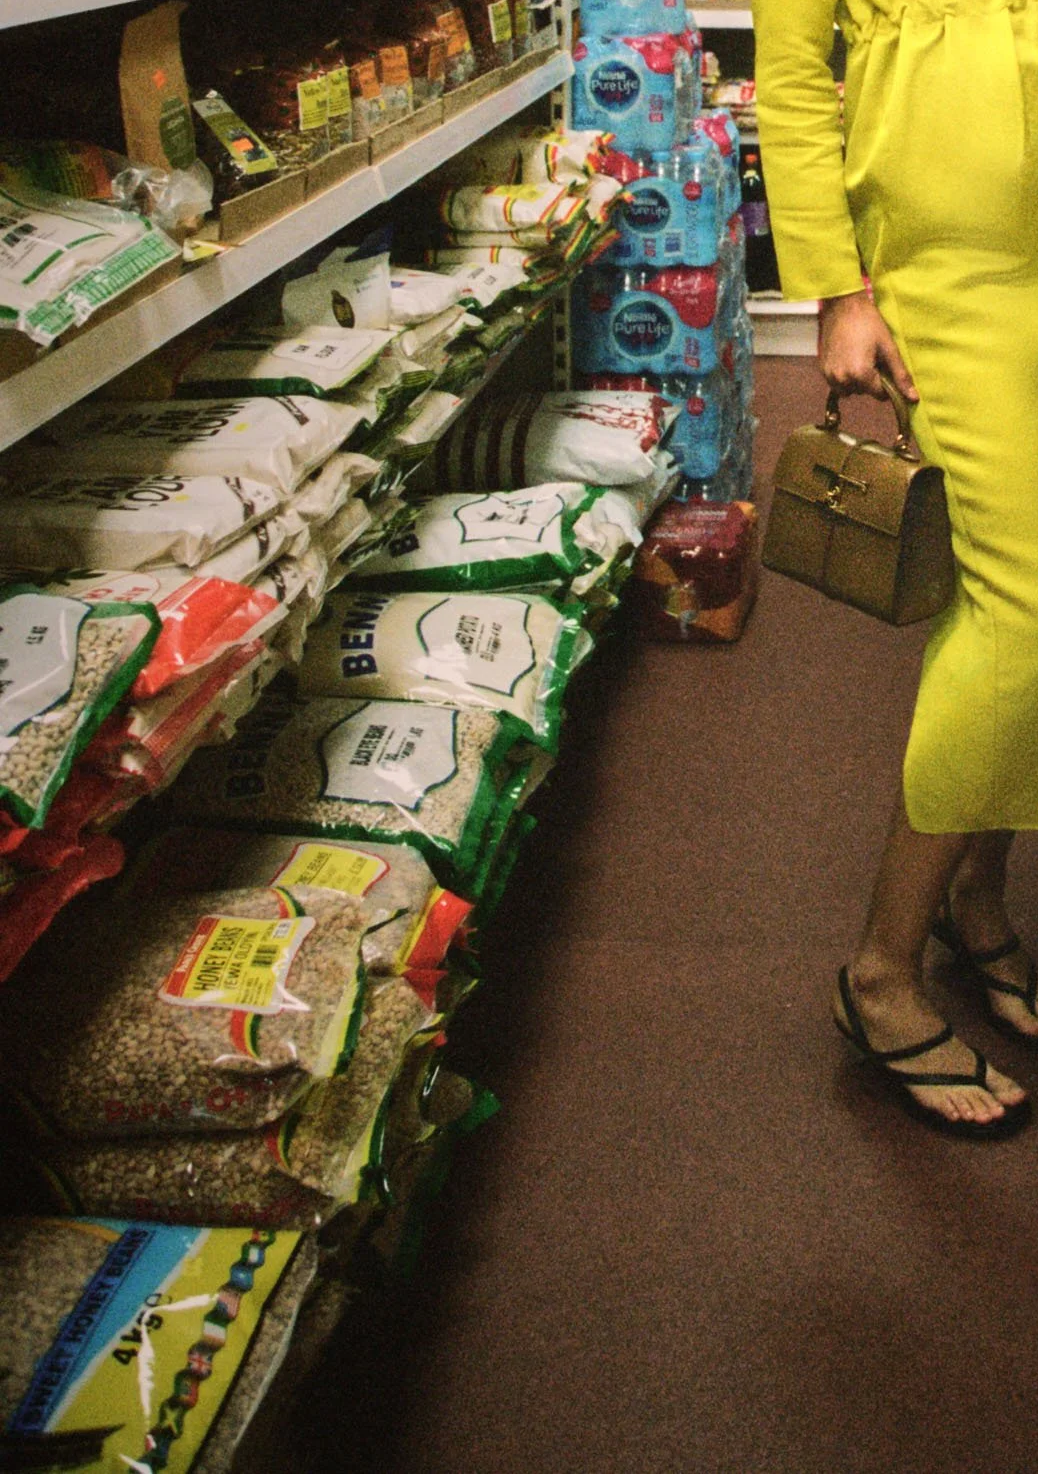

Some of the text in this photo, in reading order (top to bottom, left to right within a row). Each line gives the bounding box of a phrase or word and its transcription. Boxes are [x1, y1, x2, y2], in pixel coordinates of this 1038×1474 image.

[591, 78, 639, 95] Pure Life
[651, 204, 671, 219] Life
[615, 321, 671, 338] Pure Life
[340, 595, 392, 679] BENN
[193, 926, 245, 992] HONEY BEANS
[69, 1279, 115, 1343] HONEY
[109, 1228, 149, 1281] BEANS
